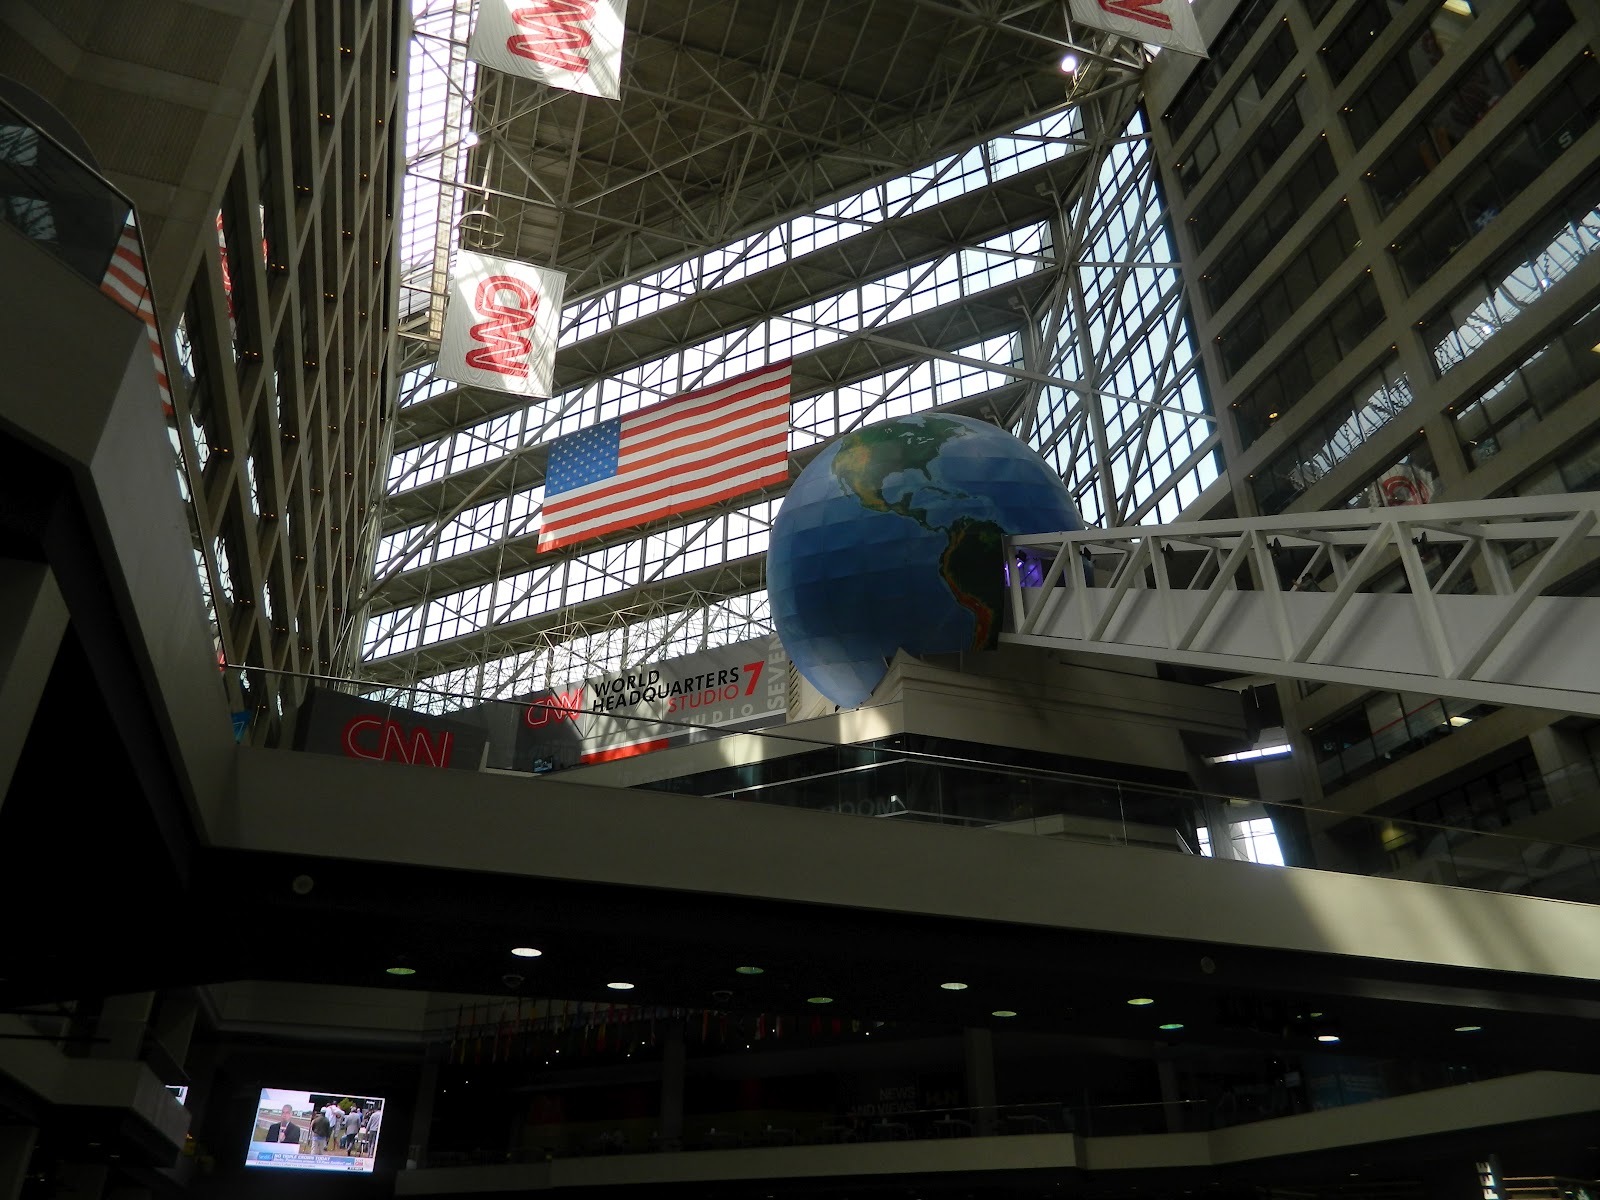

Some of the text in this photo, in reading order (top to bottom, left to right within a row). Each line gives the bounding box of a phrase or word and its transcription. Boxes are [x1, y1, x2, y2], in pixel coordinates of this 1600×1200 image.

[506, 0, 598, 74] NN
[465, 275, 540, 378] CNN
[525, 688, 583, 729] CNN
[592, 667, 739, 712] HEADQUARTERS
[594, 670, 660, 698] WORLD
[668, 660, 765, 713] STUDIO 7
[341, 714, 454, 768] CNN
